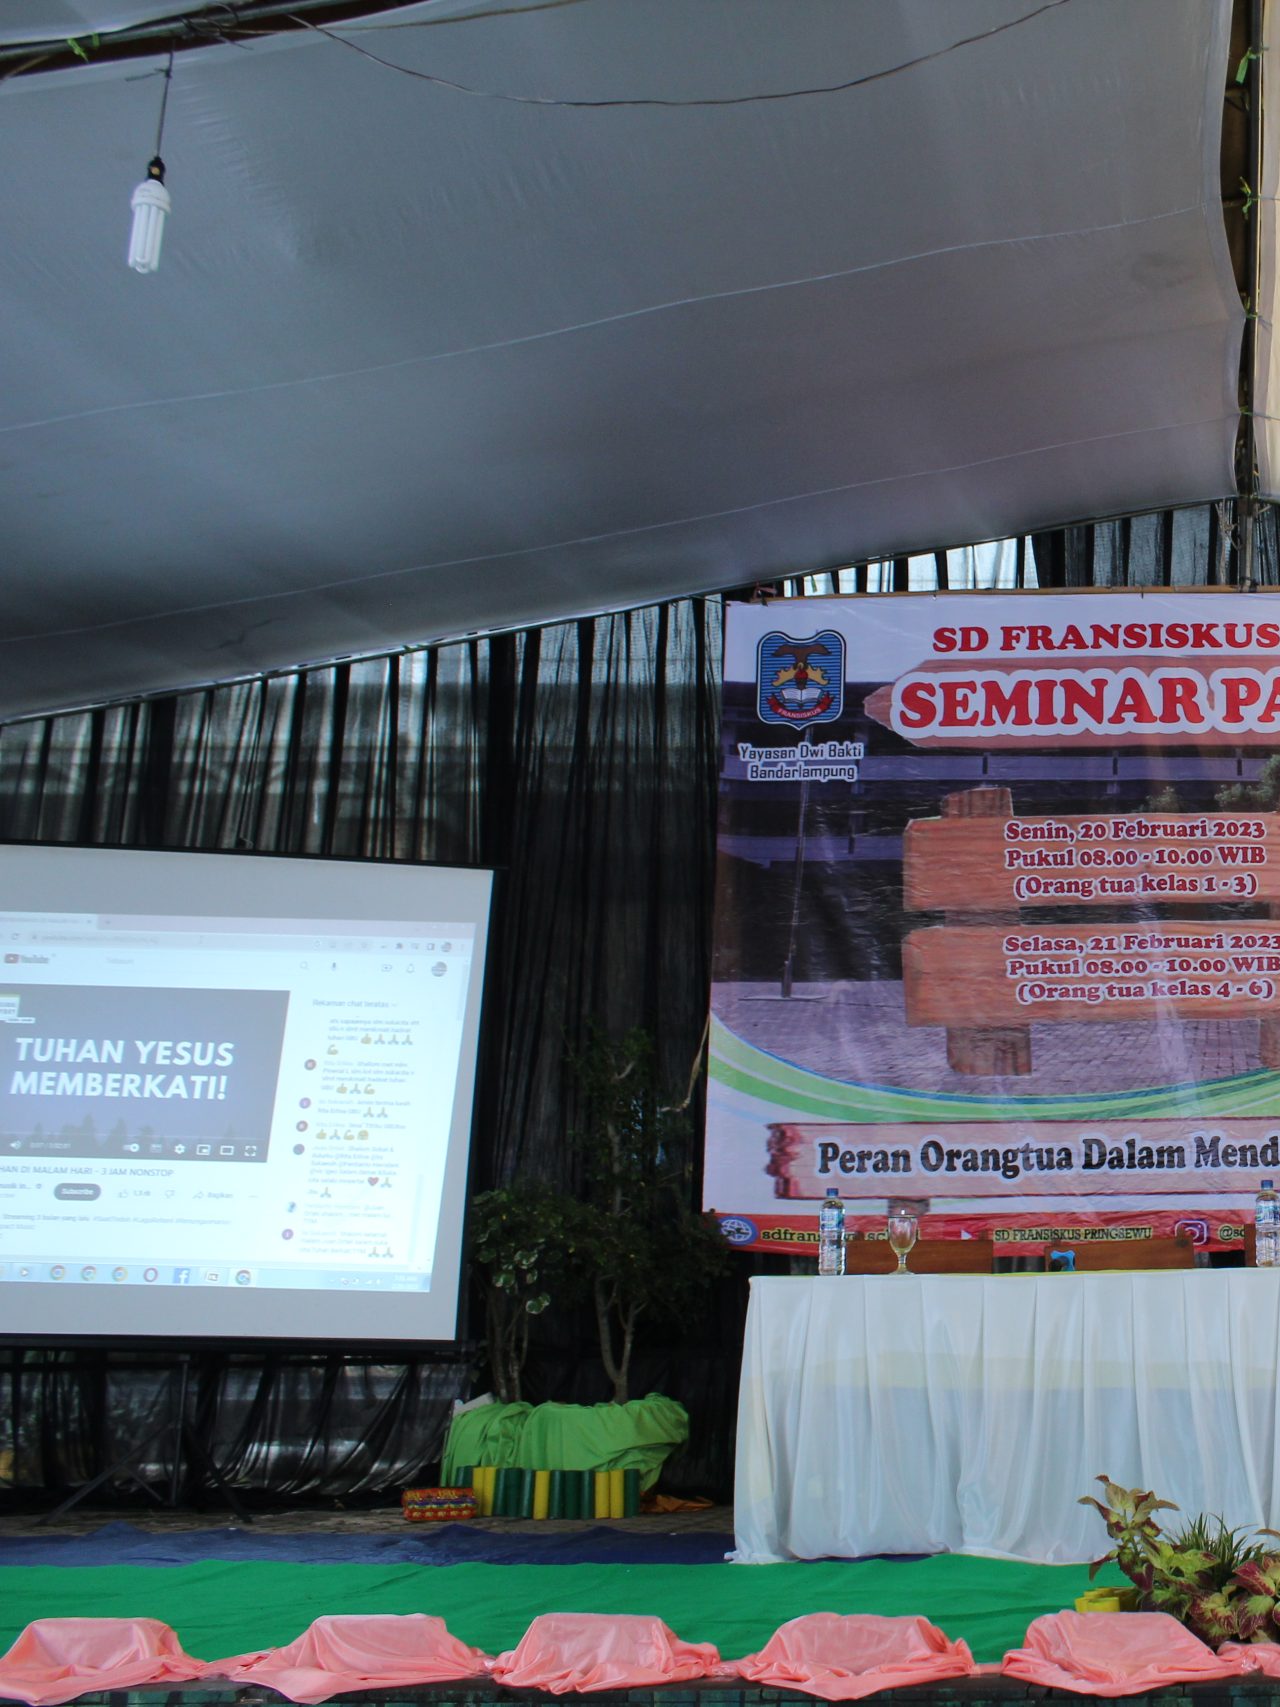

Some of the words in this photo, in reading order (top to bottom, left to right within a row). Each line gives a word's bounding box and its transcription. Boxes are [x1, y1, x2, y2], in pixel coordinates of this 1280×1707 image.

[933, 626, 989, 653] SD
[1000, 623, 1280, 651] FRANSISKUS
[778, 708, 822, 719] FRANSISKUS
[900, 677, 1205, 728] SEMINAR
[740, 745, 796, 761] Yayasan
[800, 744, 824, 758] Dwi
[828, 743, 862, 757] Bakti
[1006, 822, 1075, 843] Senin,
[1080, 824, 1107, 840] 20
[1112, 820, 1208, 838] Februari
[1213, 822, 1265, 838] 2023
[1007, 848, 1074, 867] Pukul
[1080, 850, 1137, 866] 08.00
[1155, 848, 1212, 865] 10.00
[1218, 846, 1265, 864] WIB
[1015, 876, 1093, 898] (Orang
[1099, 876, 1135, 893] tua
[1141, 875, 1198, 892] kelas
[1204, 876, 1216, 891] 1
[1233, 874, 1258, 895] 3)
[1005, 936, 1084, 953] Selasa,
[1091, 937, 1115, 951] 21
[1124, 934, 1224, 950] Februari
[1009, 959, 1081, 976] Pukul
[1086, 960, 1148, 975] 08.00
[1165, 958, 1226, 973] 10.00
[1018, 982, 1100, 1002] (Orang
[1106, 982, 1144, 998] tua
[1151, 980, 1211, 997] kelas
[1216, 981, 1230, 997] 4
[1249, 980, 1273, 999] 6)
[16, 1037, 124, 1064] TUHAN
[135, 1040, 234, 1067] YESUS
[10, 1071, 228, 1100] MEMBERKATI!
[818, 1142, 911, 1174] Peran
[919, 1140, 1074, 1180] Orangtua
[1082, 1138, 1187, 1172] Dalam
[0, 1166, 18, 1174] HAN
[33, 1166, 68, 1175] MALAM
[70, 1167, 92, 1175] HARI
[109, 1168, 127, 1176] JAM
[130, 1168, 174, 1177] NONSTOP
[994, 1229, 1010, 1241] SD
[1013, 1227, 1081, 1240] FRANSISKUS
[1084, 1227, 1152, 1240] PRINGSEWU
